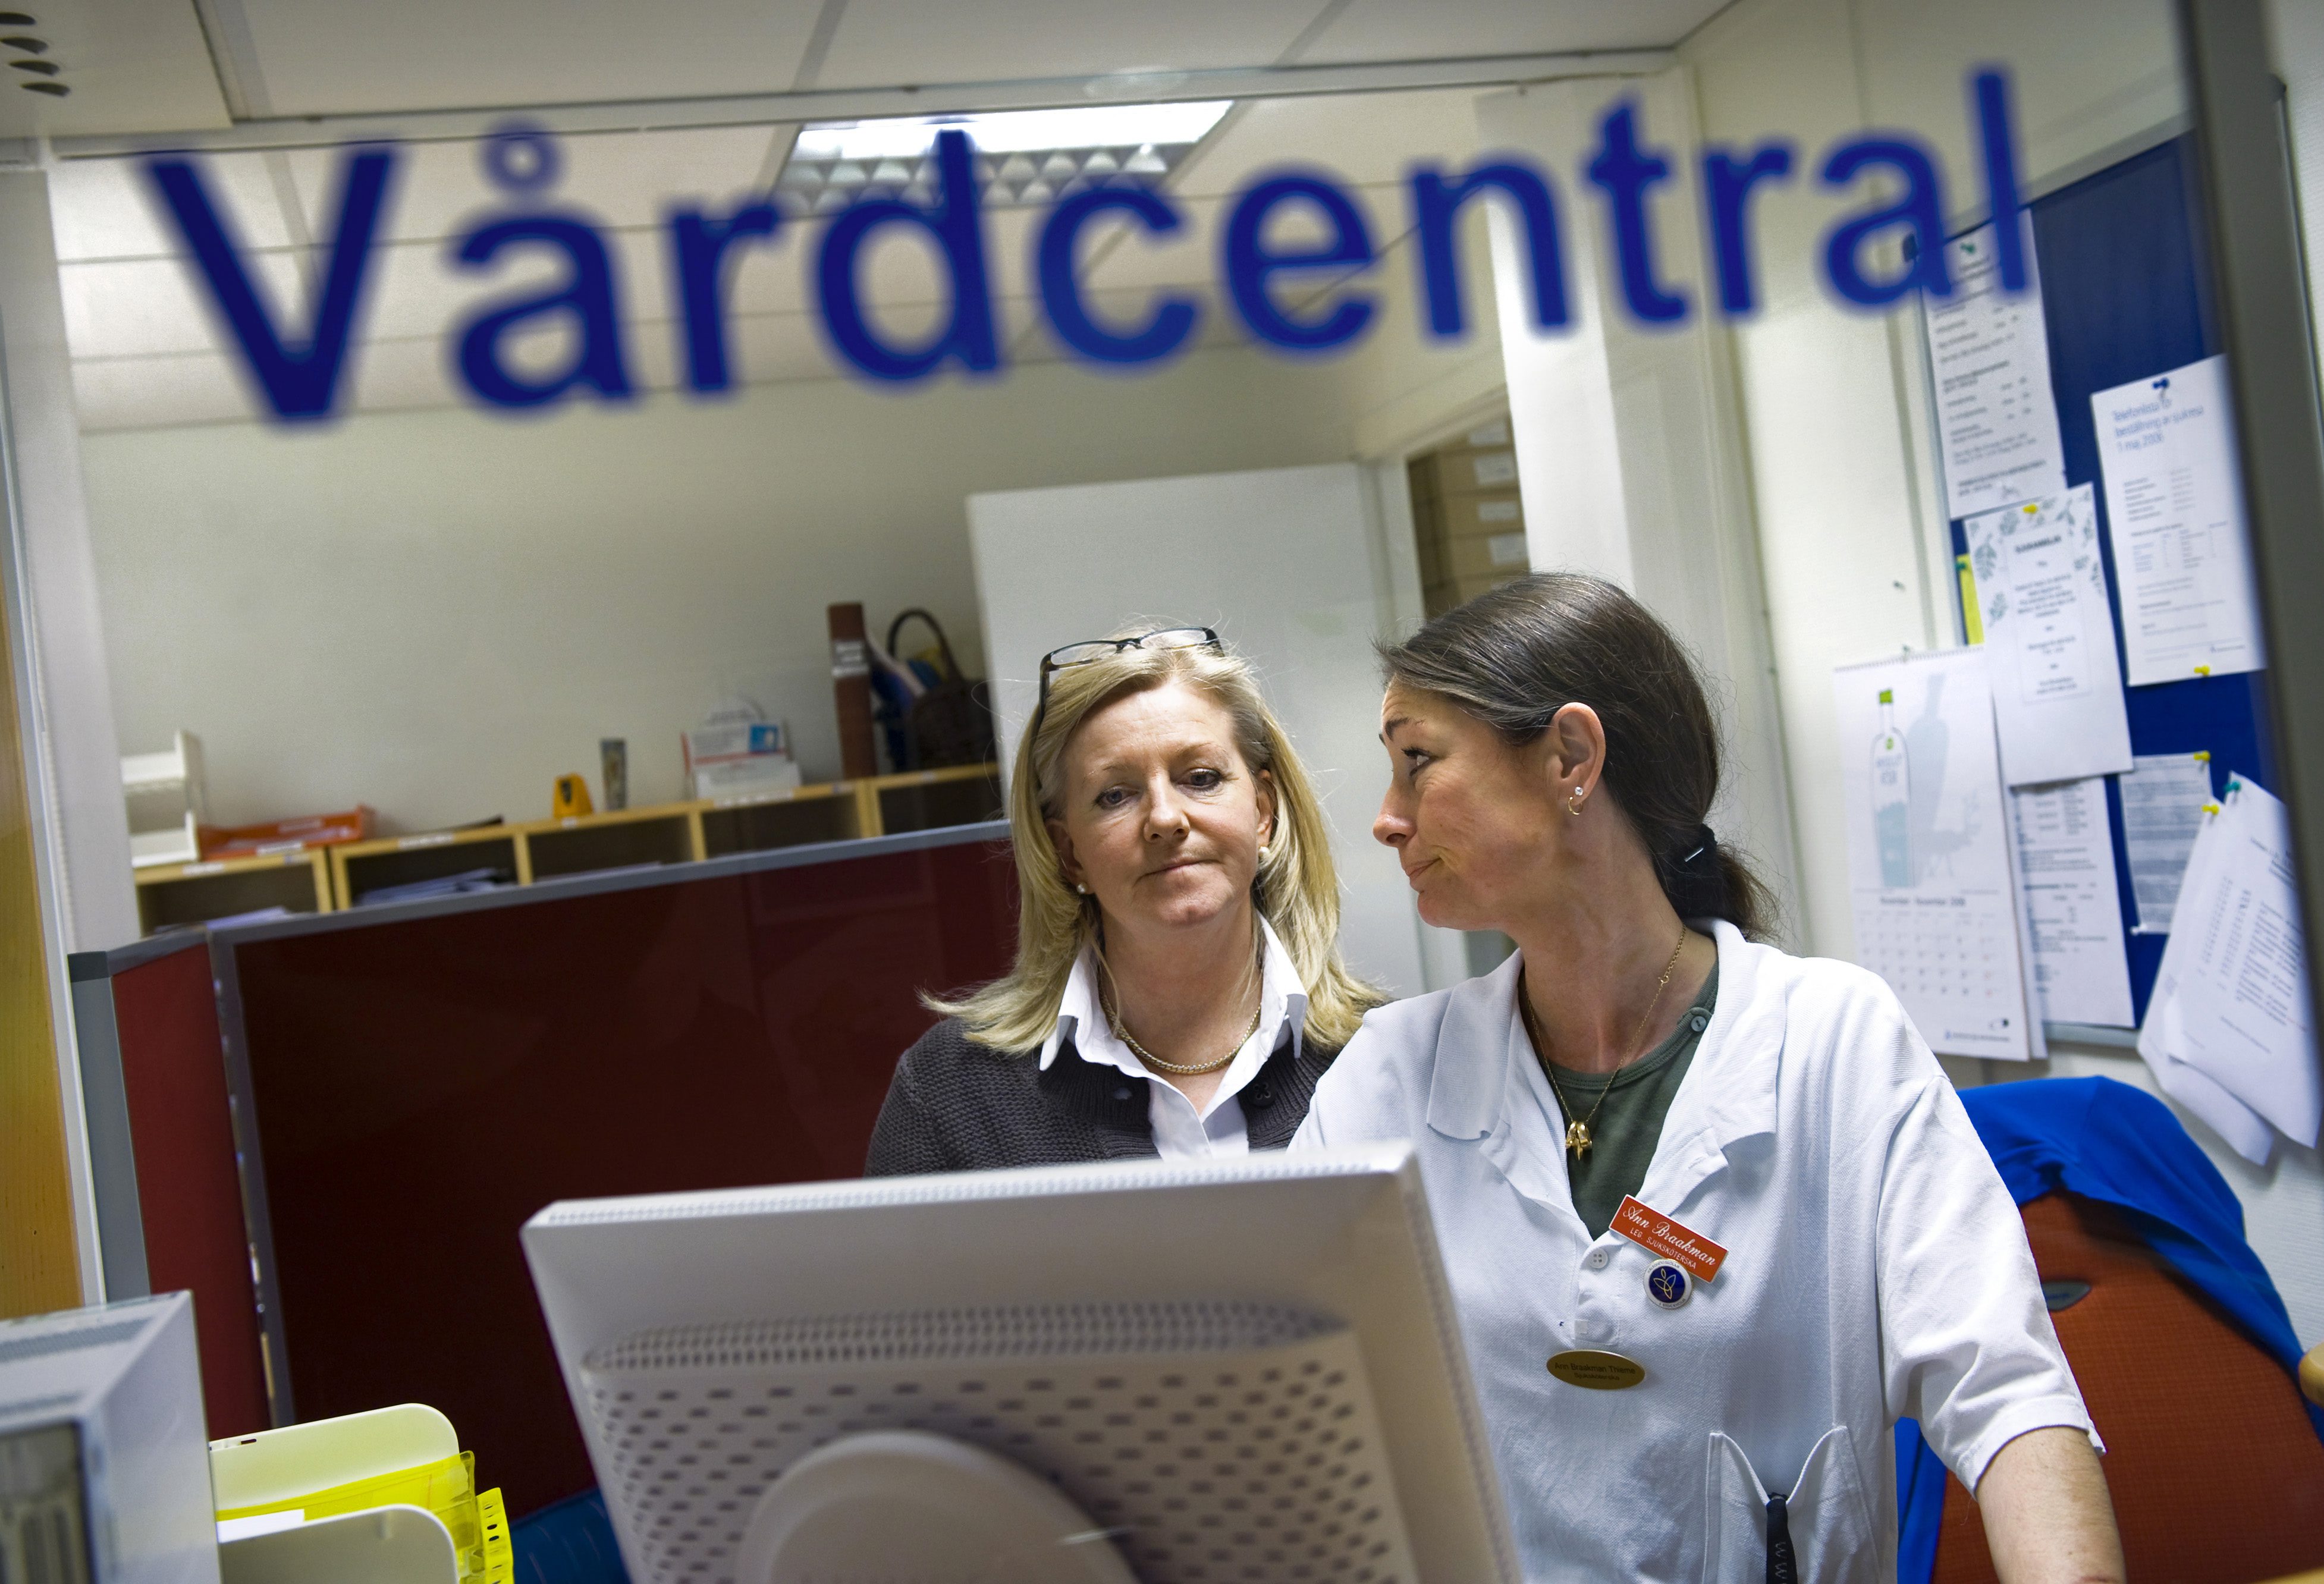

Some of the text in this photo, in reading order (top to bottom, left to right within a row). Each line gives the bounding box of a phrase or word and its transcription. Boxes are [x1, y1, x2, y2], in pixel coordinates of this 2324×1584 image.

[145, 67, 2029, 427] Vårdcentral
[1622, 1206, 1716, 1266] Ann Braakman
[1646, 1236, 1697, 1269] SJUKSKÖTERSKA
[1570, 1362, 1607, 1372] Braakman
